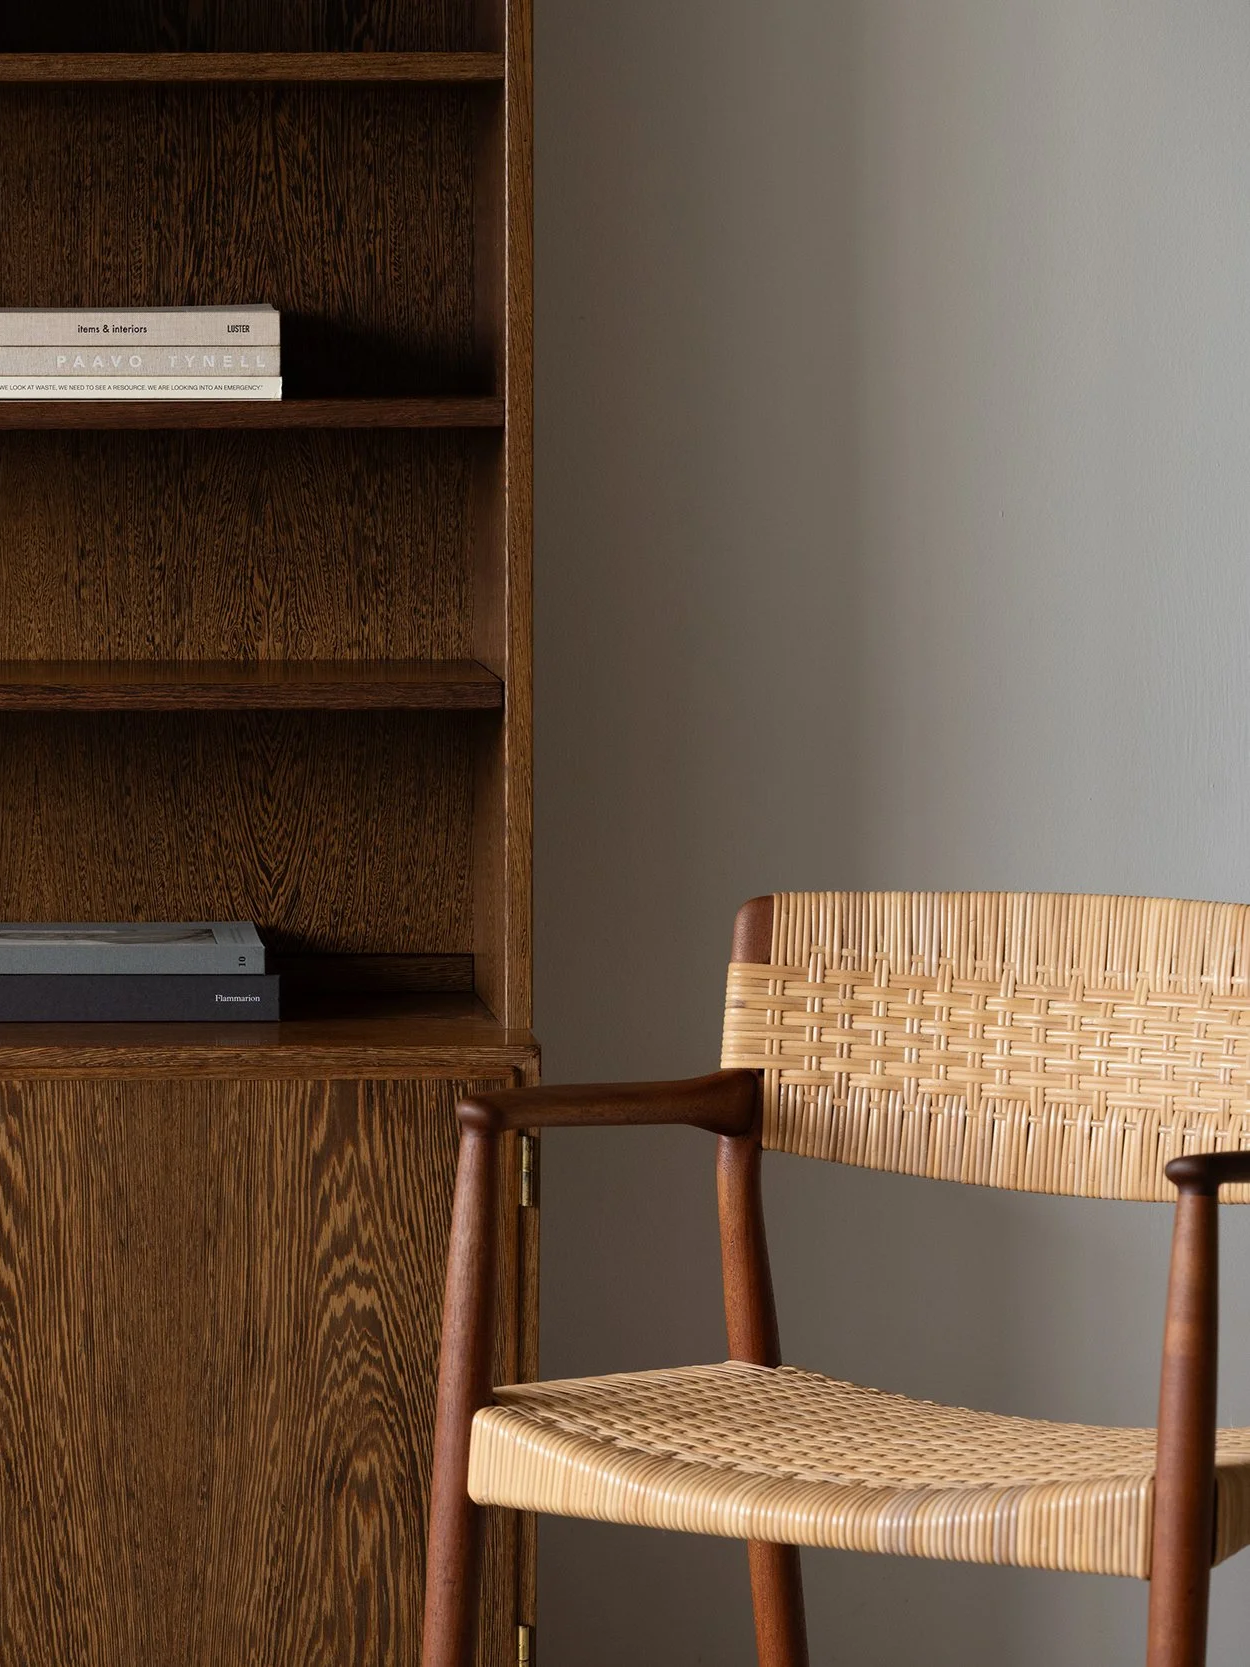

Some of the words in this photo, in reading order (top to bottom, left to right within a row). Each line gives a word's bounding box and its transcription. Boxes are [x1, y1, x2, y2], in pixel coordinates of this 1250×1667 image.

[77, 324, 100, 334] items
[102, 325, 110, 334] &
[112, 324, 148, 334] interiors
[227, 324, 250, 333] LUSTER
[56, 355, 142, 368] PAAVO
[168, 355, 266, 368] TYNELL
[238, 956, 246, 967] 10
[215, 994, 261, 1002] Flammarion
